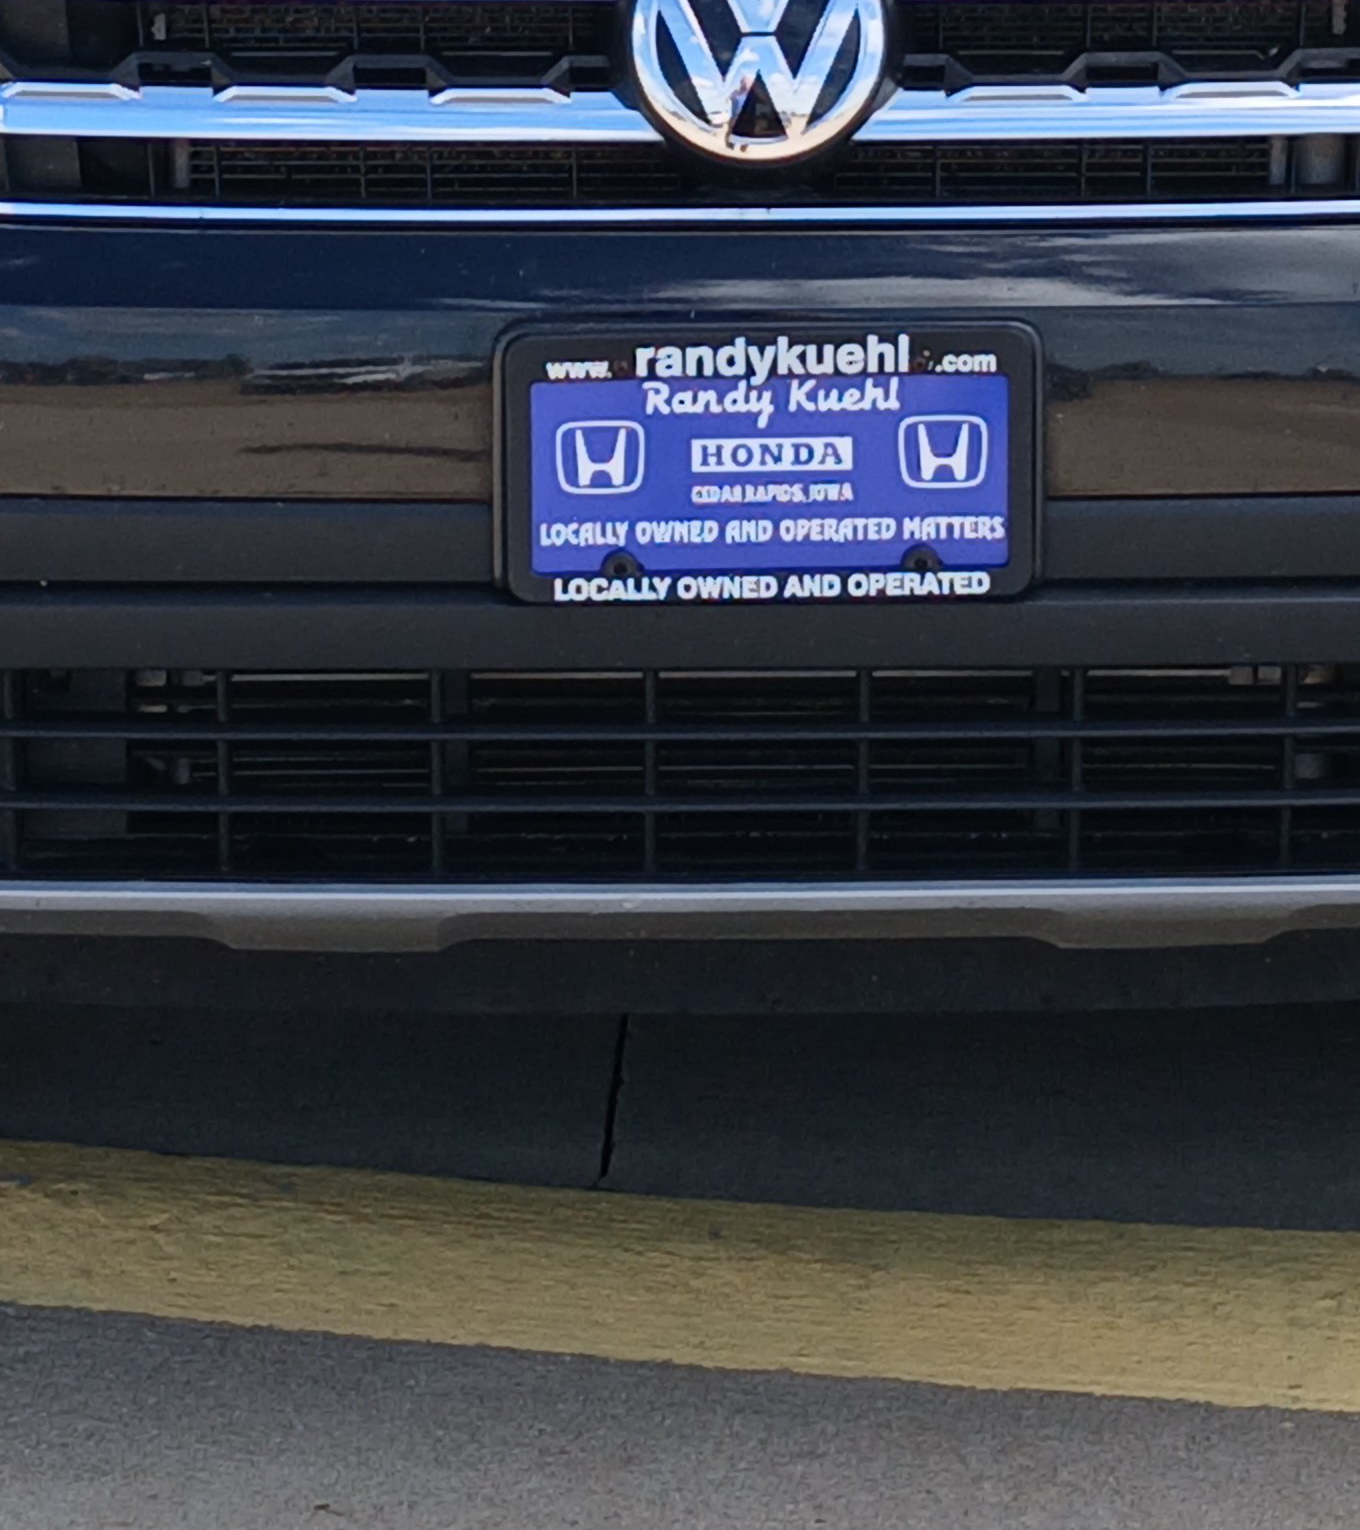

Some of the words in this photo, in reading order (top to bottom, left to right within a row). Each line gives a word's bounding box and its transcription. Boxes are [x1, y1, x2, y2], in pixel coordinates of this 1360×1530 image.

[635, 333, 910, 386] randykuehl
[934, 353, 998, 373] .com
[642, 379, 774, 429] Randy
[788, 376, 901, 413] Kuehl
[699, 442, 843, 468] HONDA
[540, 521, 629, 547] LOCALLY
[635, 520, 720, 544] OWNED
[725, 519, 774, 544] AND
[779, 517, 897, 543] OPERATED
[902, 516, 1006, 541] MATTERS
[554, 577, 672, 601] LOCALLY
[677, 575, 779, 600] OWNED
[783, 574, 842, 598] AND
[847, 571, 991, 597] OPERATED
